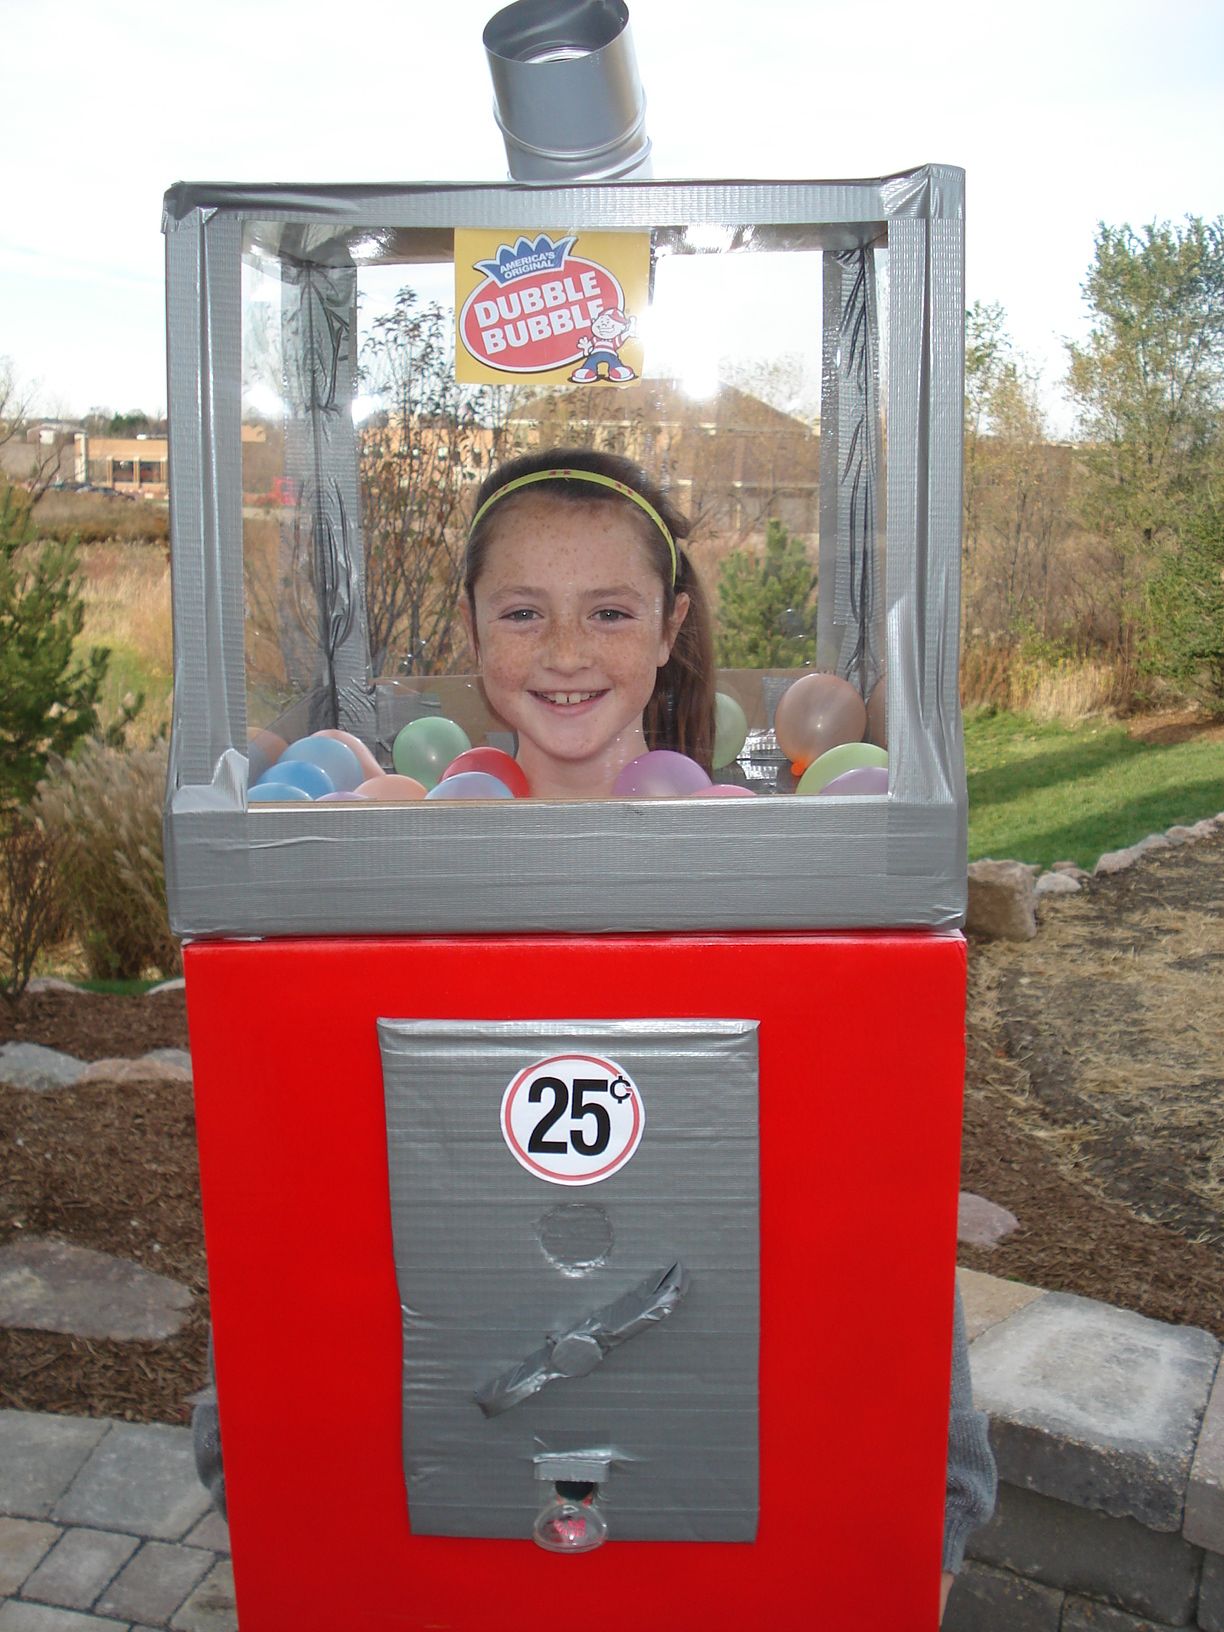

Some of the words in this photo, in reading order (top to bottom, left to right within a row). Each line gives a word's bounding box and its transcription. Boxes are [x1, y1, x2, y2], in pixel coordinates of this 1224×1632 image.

[500, 251, 556, 274] AMERICA'S
[504, 260, 555, 280] ORIGINAL
[473, 271, 602, 329] DUBBLE
[527, 1075, 632, 1157] 25¢
